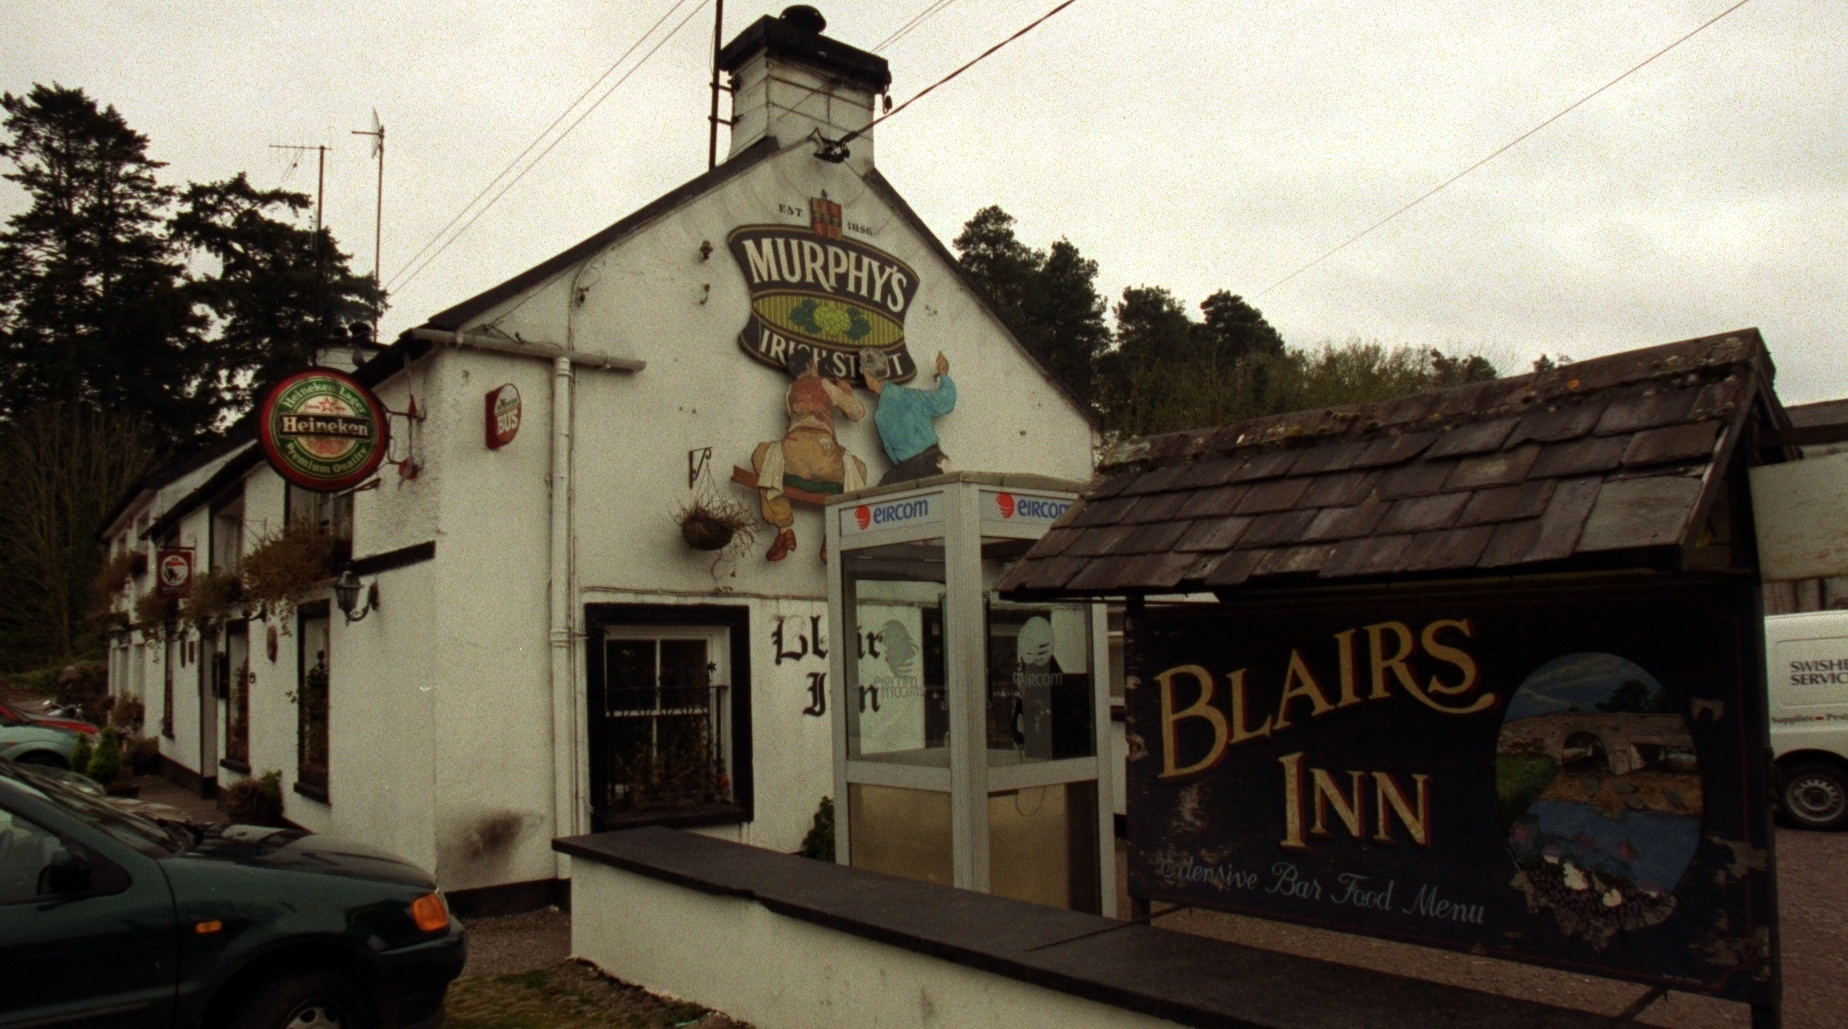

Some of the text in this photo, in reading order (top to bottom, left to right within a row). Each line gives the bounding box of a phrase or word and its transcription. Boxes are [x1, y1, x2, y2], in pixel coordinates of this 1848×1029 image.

[778, 203, 803, 217] EST
[742, 238, 907, 312] MURPHY'S
[282, 417, 369, 436] Heineken
[286, 442, 367, 473] Premium Quality
[1153, 618, 1498, 779] BLAIRS
[1279, 751, 1431, 851] INN
[1265, 860, 1322, 900] Bar
[1330, 872, 1393, 911] Food
[1402, 883, 1486, 924] Menu
